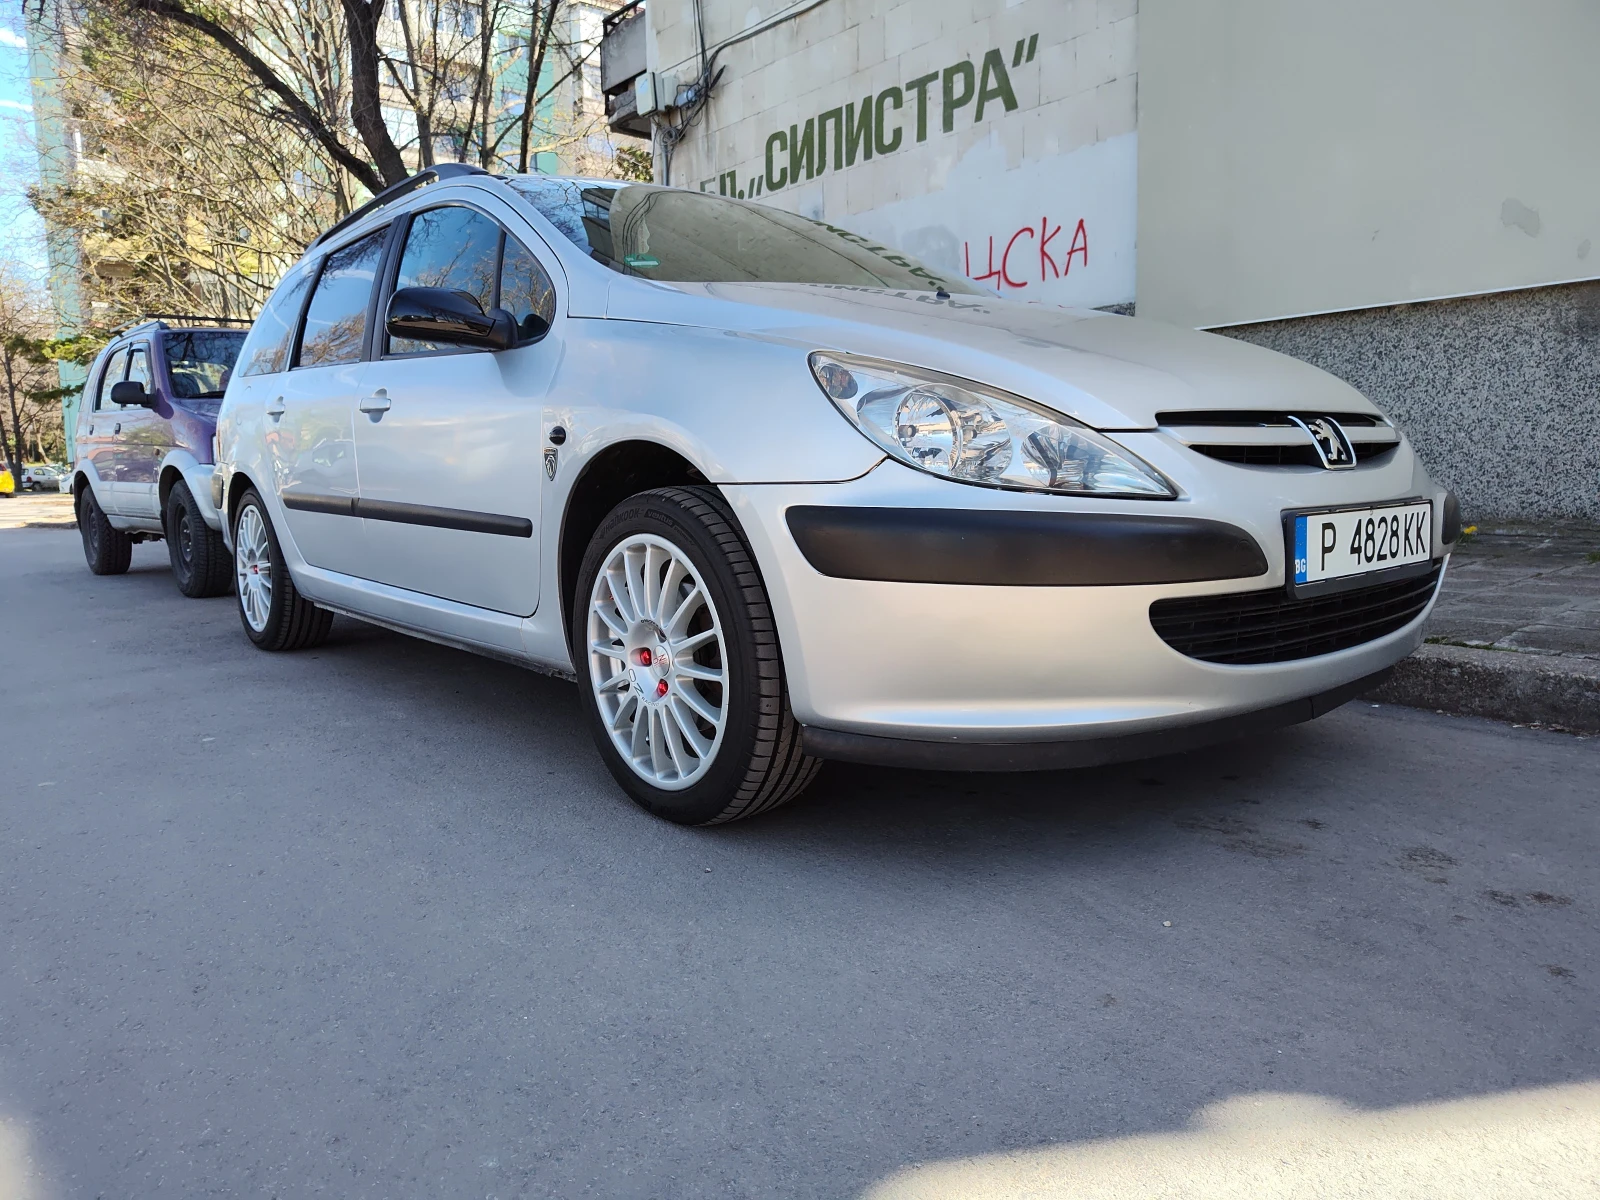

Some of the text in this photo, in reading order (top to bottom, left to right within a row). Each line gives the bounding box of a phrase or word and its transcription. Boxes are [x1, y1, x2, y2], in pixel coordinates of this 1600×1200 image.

[965, 216, 1088, 291] ЦСКА
[1294, 558, 1307, 575] BG
[1321, 522, 1337, 571] P
